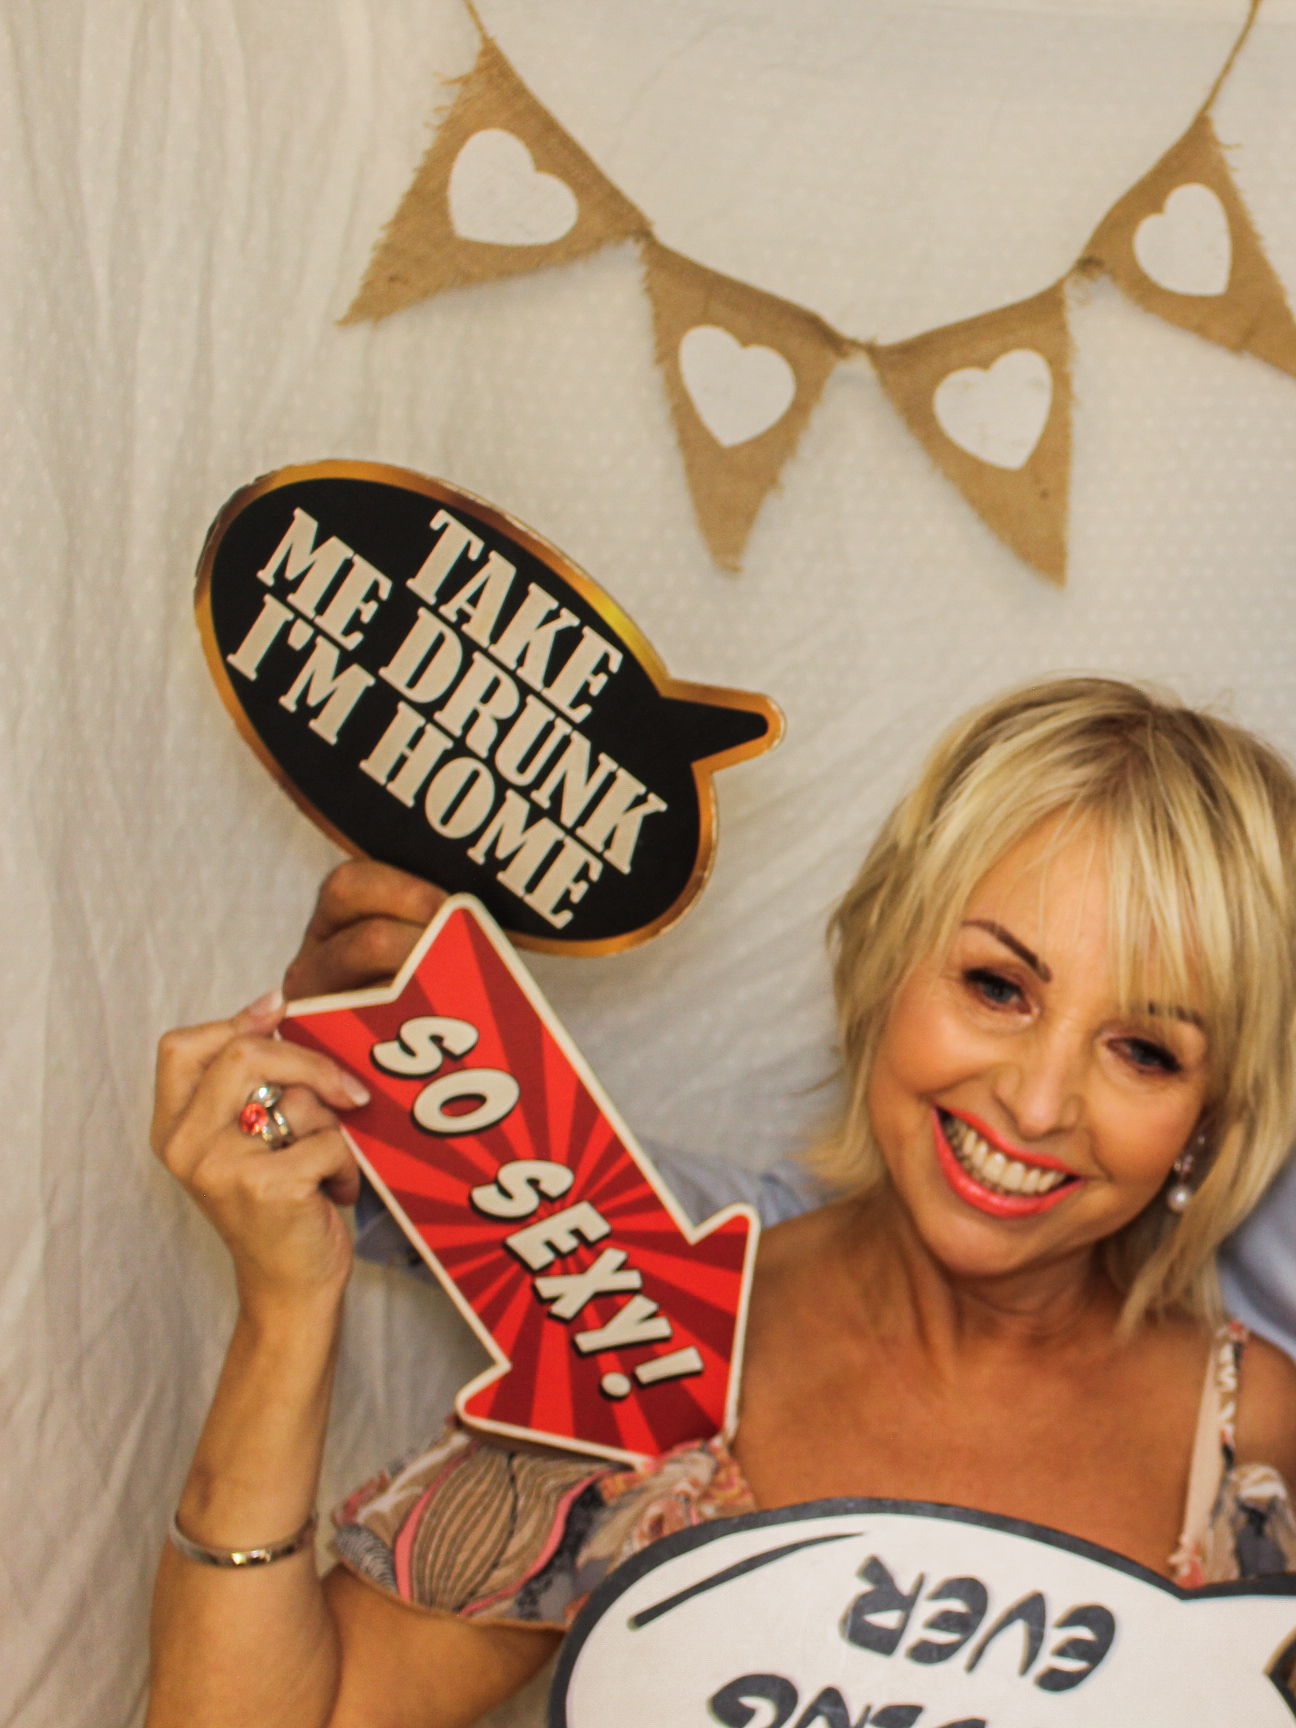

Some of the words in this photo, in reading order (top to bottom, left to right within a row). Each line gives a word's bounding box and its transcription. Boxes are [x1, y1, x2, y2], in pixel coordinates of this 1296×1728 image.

[226, 593, 376, 745] I'M
[359, 701, 603, 929] HOME
[256, 507, 393, 651] ME
[379, 607, 668, 874] DRUNK
[406, 509, 623, 723] TAKE
[370, 1015, 520, 1137] SO
[470, 1160, 704, 1401] SEXY!
[839, 1554, 1117, 1693] EVER
